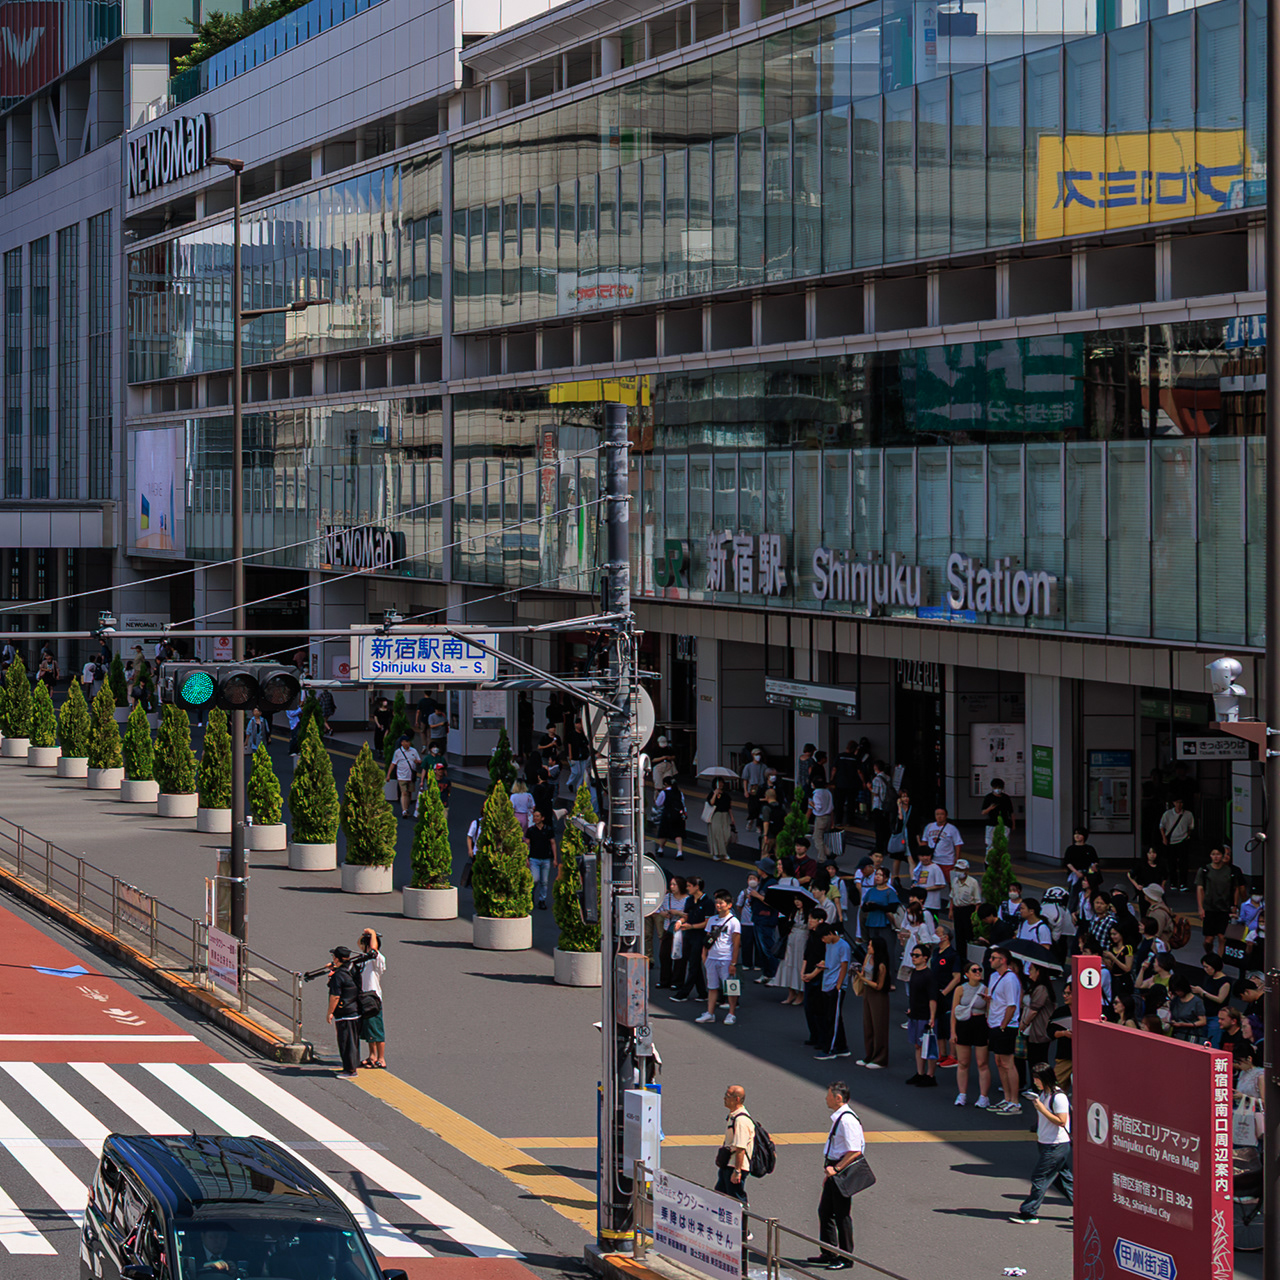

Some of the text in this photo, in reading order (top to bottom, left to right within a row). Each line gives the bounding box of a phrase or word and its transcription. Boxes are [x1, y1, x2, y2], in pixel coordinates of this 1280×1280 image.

[706, 531, 1052, 616] 新宿駅 Shinjuku Station
[370, 636, 487, 660] 新宿駅南口
[372, 660, 426, 675] Shinjuku
[431, 660, 455, 674] Sta.
[474, 660, 486, 674] S.
[897, 659, 940, 687] PIZZERIA
[623, 902, 635, 932] 交通
[1225, 945, 1245, 959] BOSS
[1112, 1112, 1201, 1153] 新宿区エリアマップ
[1214, 1057, 1229, 1193] 新宿駅南口周辺案内
[1112, 1134, 1200, 1172] Shinjuku City Area Map
[1112, 1172, 1193, 1210] 新宿区新宿3丁目 38-2
[1132, 1197, 1157, 1218] Shinjuku
[1157, 1206, 1171, 1222] City
[1120, 1242, 1170, 1278] 甲州街道
